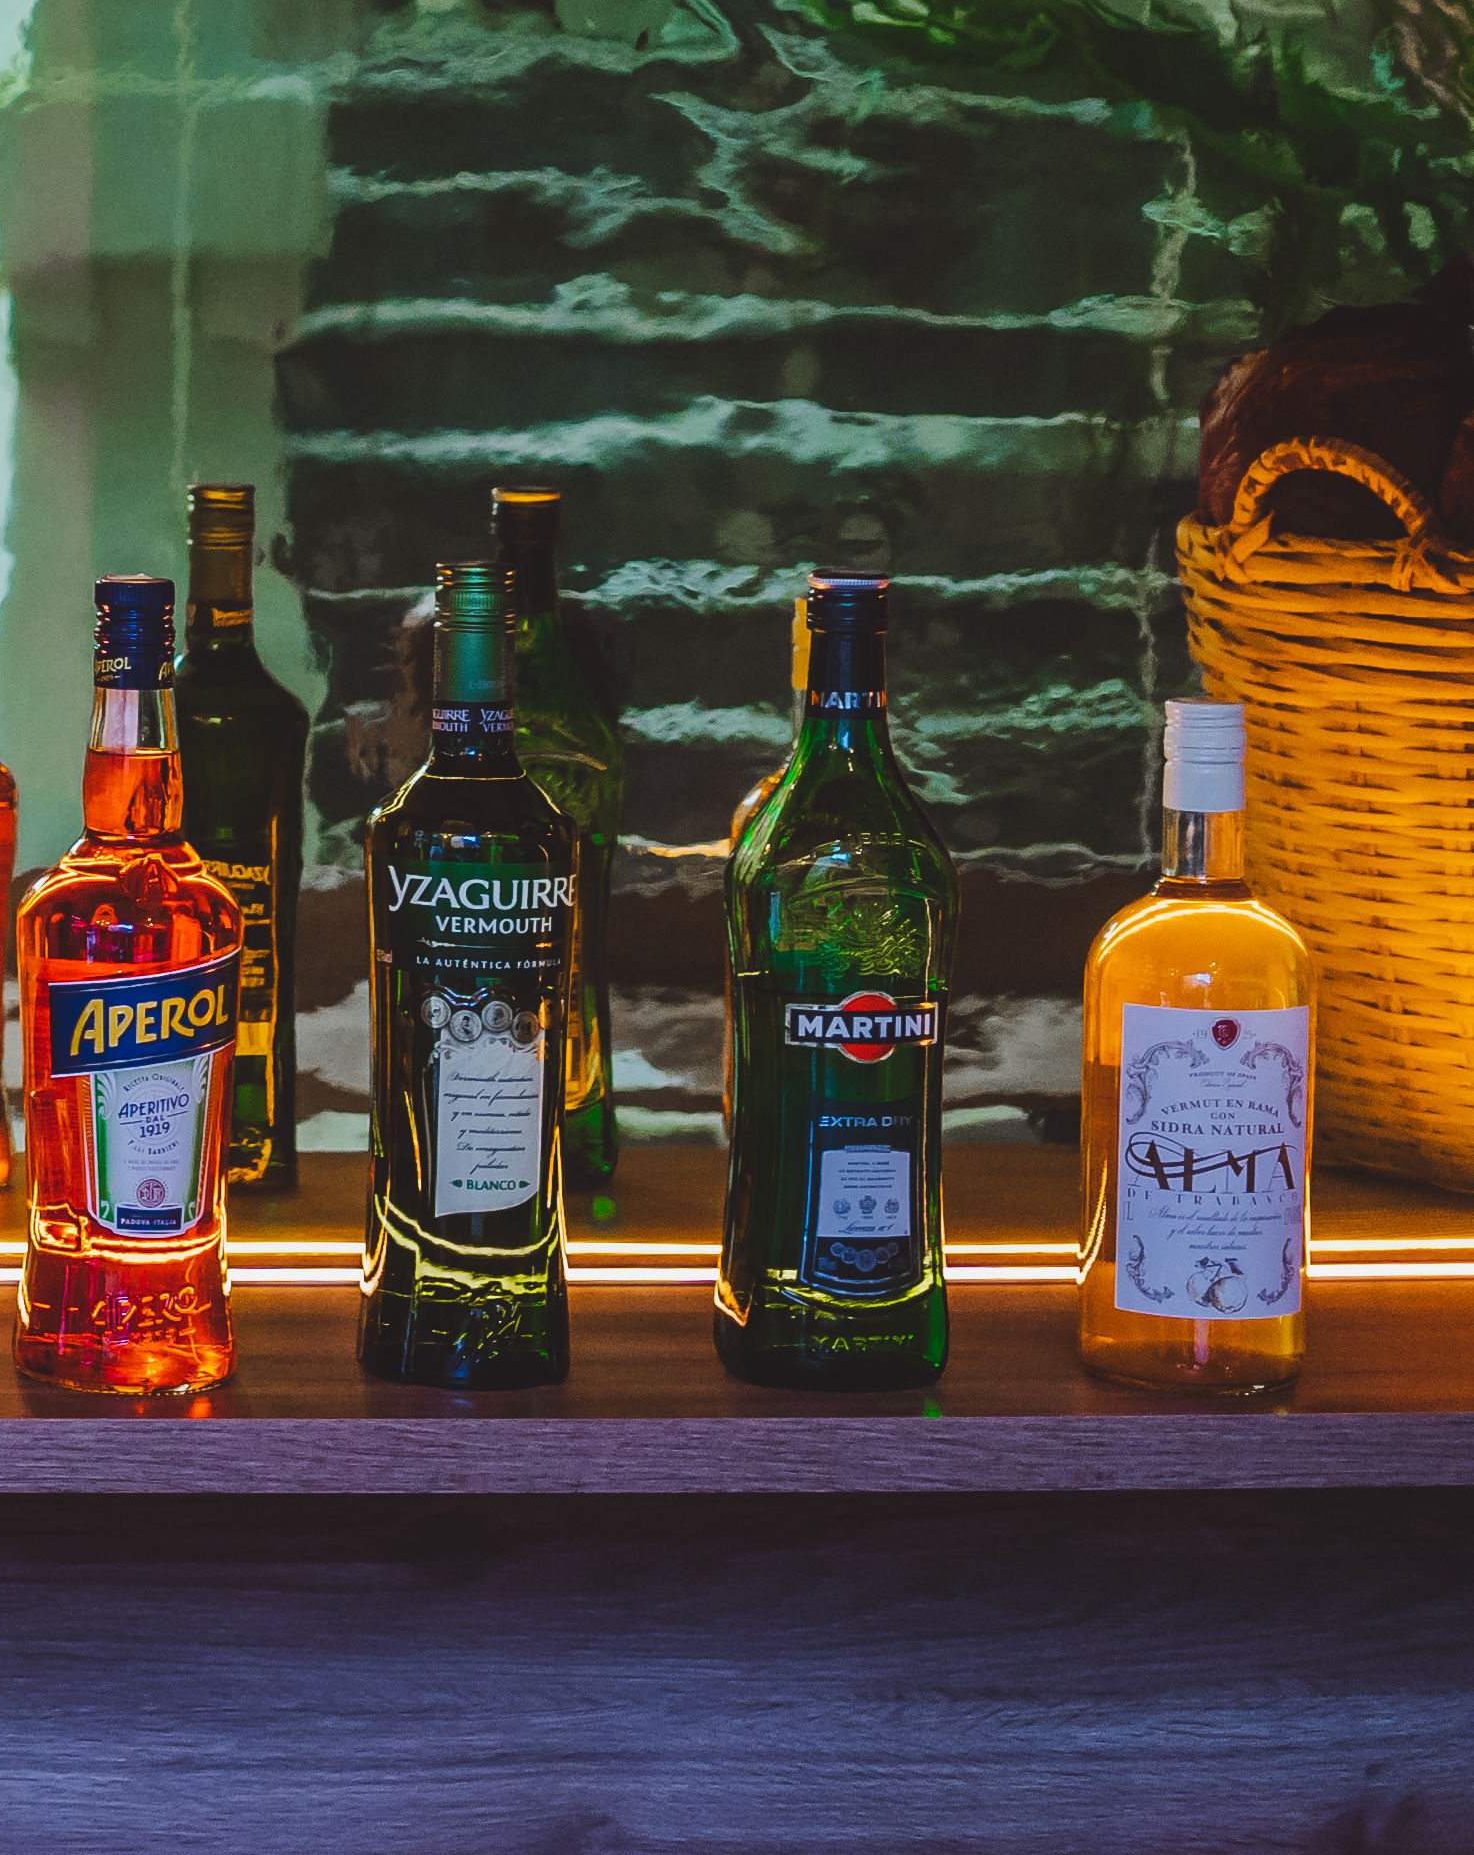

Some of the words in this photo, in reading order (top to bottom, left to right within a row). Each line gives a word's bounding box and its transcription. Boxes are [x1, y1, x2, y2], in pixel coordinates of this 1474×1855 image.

[435, 915, 553, 935] VERMOUTH
[416, 955, 429, 965] LA
[435, 956, 511, 970] AUTÉNTICA
[70, 984, 229, 1057] APEROL
[797, 1013, 931, 1039] MARTINI
[117, 1093, 190, 1119] APERITIVO
[1161, 1098, 1222, 1116] VERMUT
[1226, 1098, 1245, 1109] EN
[1248, 1101, 1280, 1118] RAMA
[145, 1115, 165, 1123] DAL
[819, 1115, 878, 1128] EXTRA
[881, 1115, 914, 1128] DRY
[1210, 1111, 1236, 1121] CON
[139, 1121, 171, 1139] 1919
[1150, 1120, 1205, 1135] SIDRA
[1210, 1122, 1285, 1136] NATURAL
[1125, 1131, 1298, 1194] ALMA
[466, 1178, 517, 1191] BLANCO
